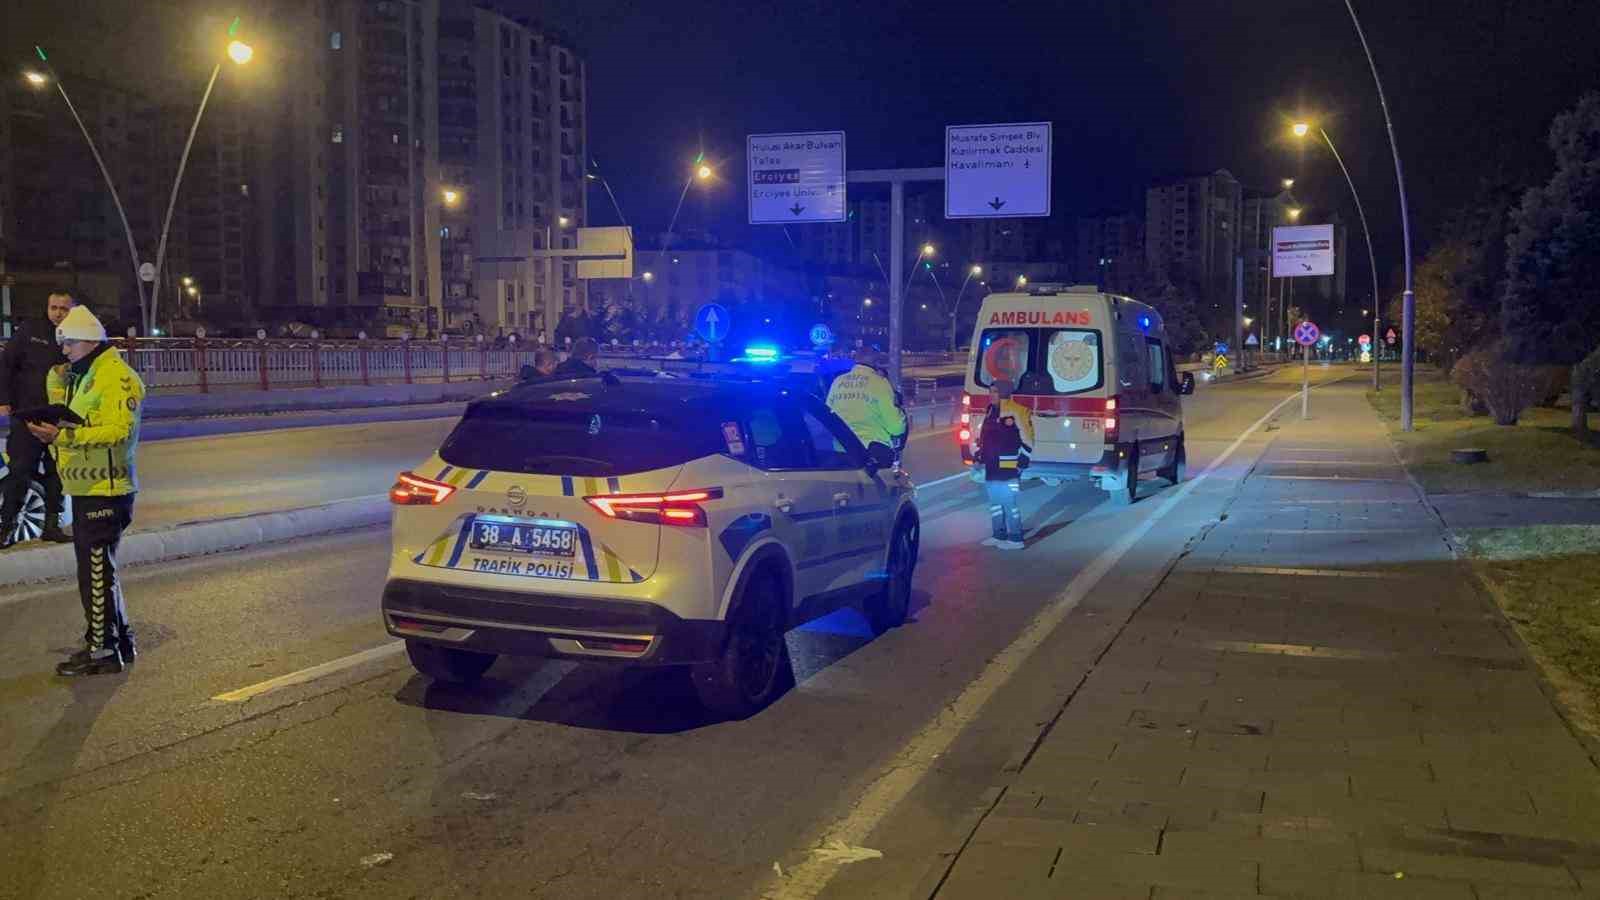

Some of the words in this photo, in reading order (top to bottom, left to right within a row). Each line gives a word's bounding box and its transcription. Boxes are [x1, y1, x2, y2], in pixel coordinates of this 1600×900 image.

[990, 310, 1091, 326] AMBULANS
[480, 524, 499, 544] 38
[511, 527, 521, 546] A
[532, 528, 571, 549] 5458
[472, 557, 522, 574] TRAFİK
[526, 562, 574, 578] POLİSİ
